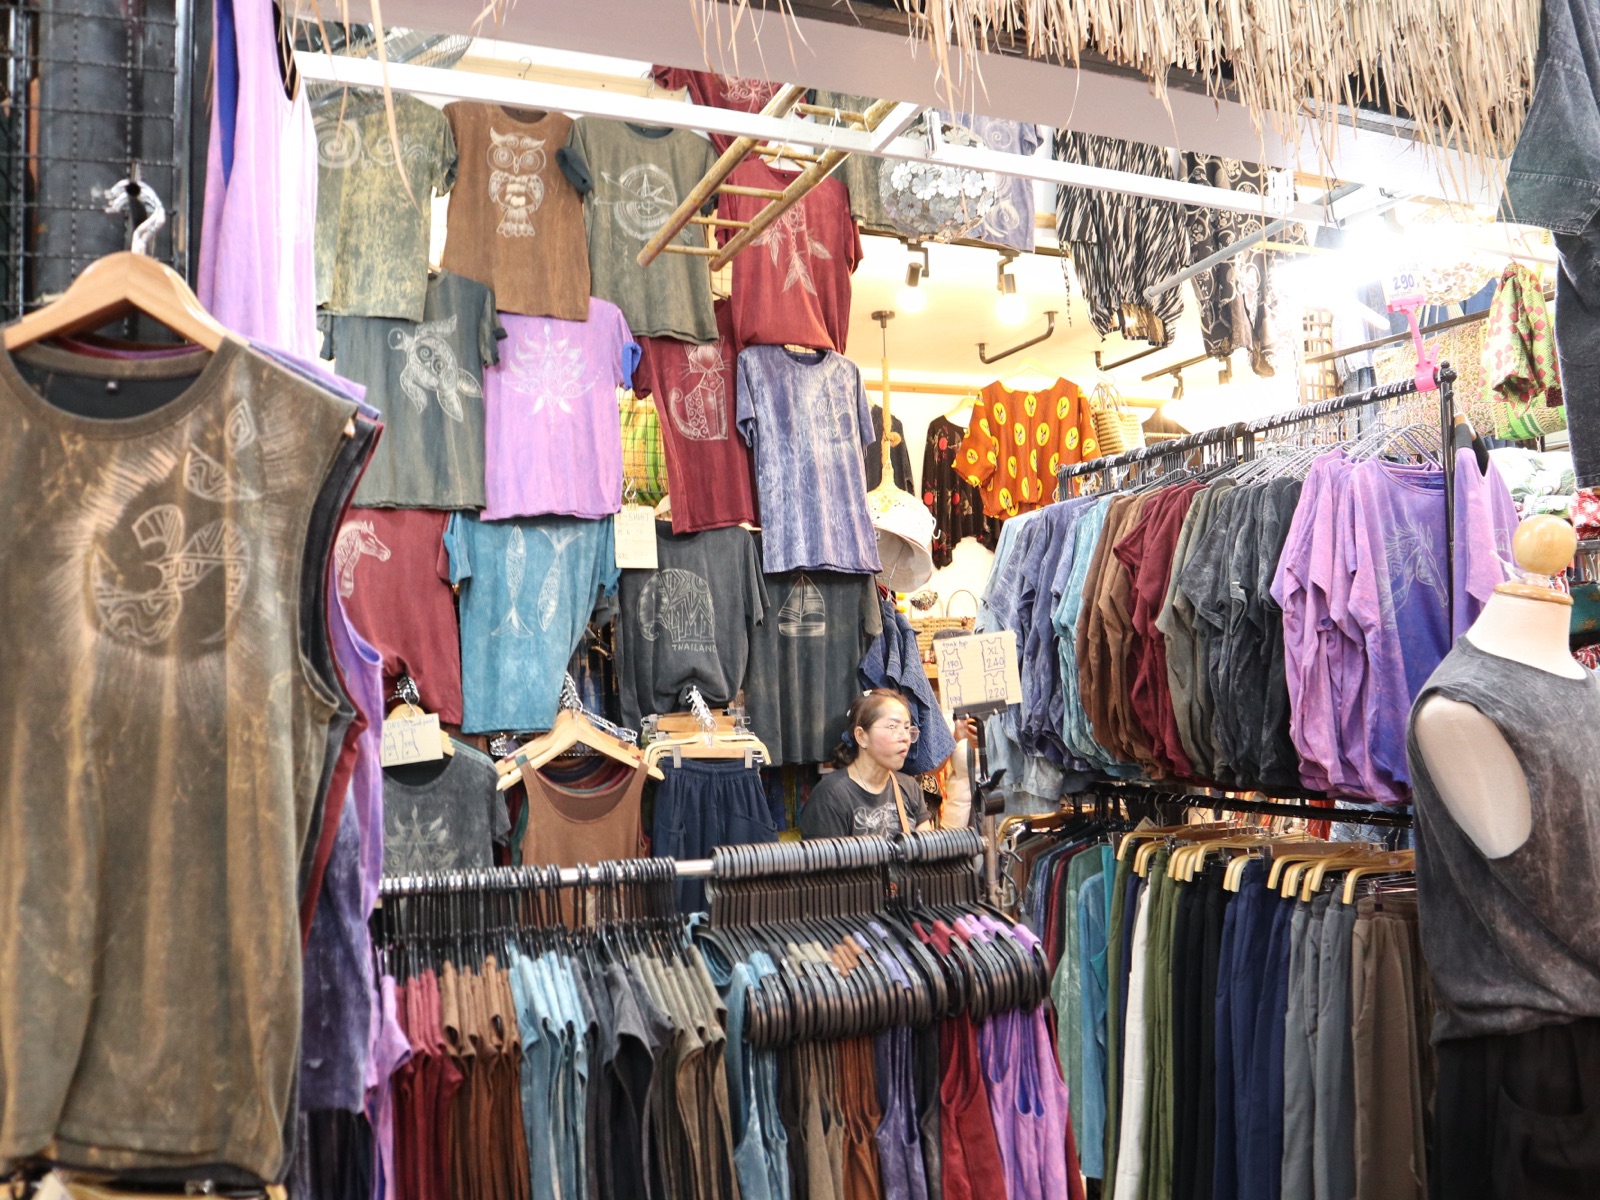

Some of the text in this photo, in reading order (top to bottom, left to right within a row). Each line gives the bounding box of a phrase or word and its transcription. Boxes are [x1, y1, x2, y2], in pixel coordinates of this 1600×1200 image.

[672, 643, 717, 652] THAILAND
[988, 646, 1000, 655] XL
[986, 656, 1005, 669] 240
[988, 687, 1005, 699] 220
